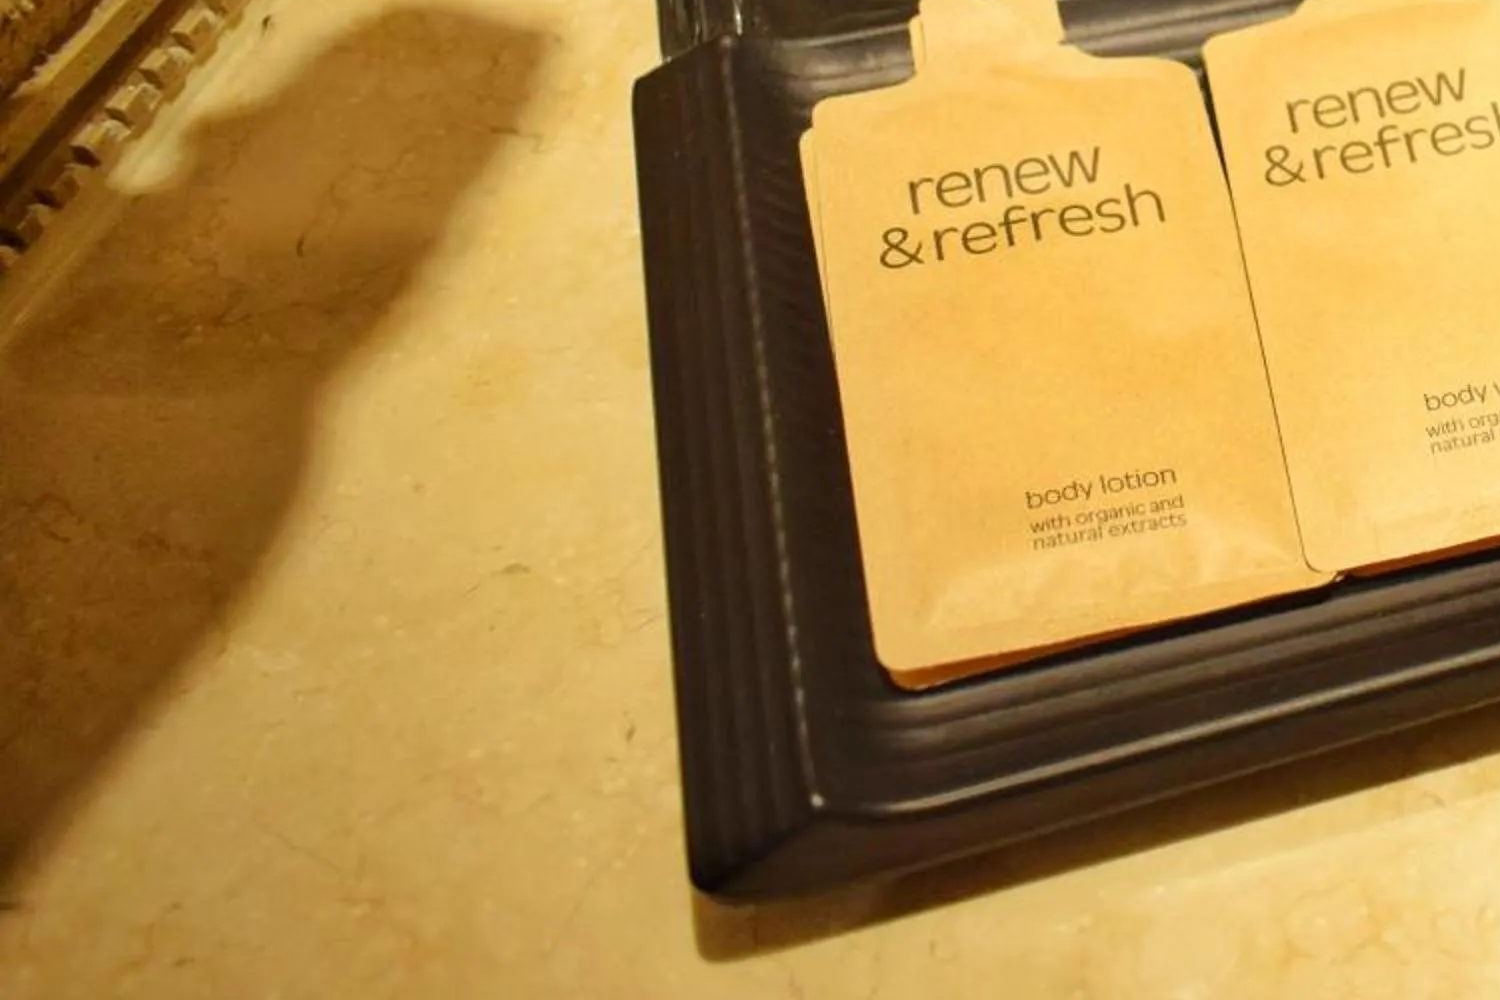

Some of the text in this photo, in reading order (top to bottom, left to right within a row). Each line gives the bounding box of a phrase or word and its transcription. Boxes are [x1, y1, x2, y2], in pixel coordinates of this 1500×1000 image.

[1285, 66, 1466, 135] renew
[908, 146, 1100, 216] renew
[1423, 383, 1488, 412] body
[1425, 417, 1465, 438] with
[1430, 427, 1496, 455] natural
[1024, 468, 1178, 510] body lotion
[1029, 494, 1185, 534] with organic and
[1032, 511, 1188, 551] natural extracts
